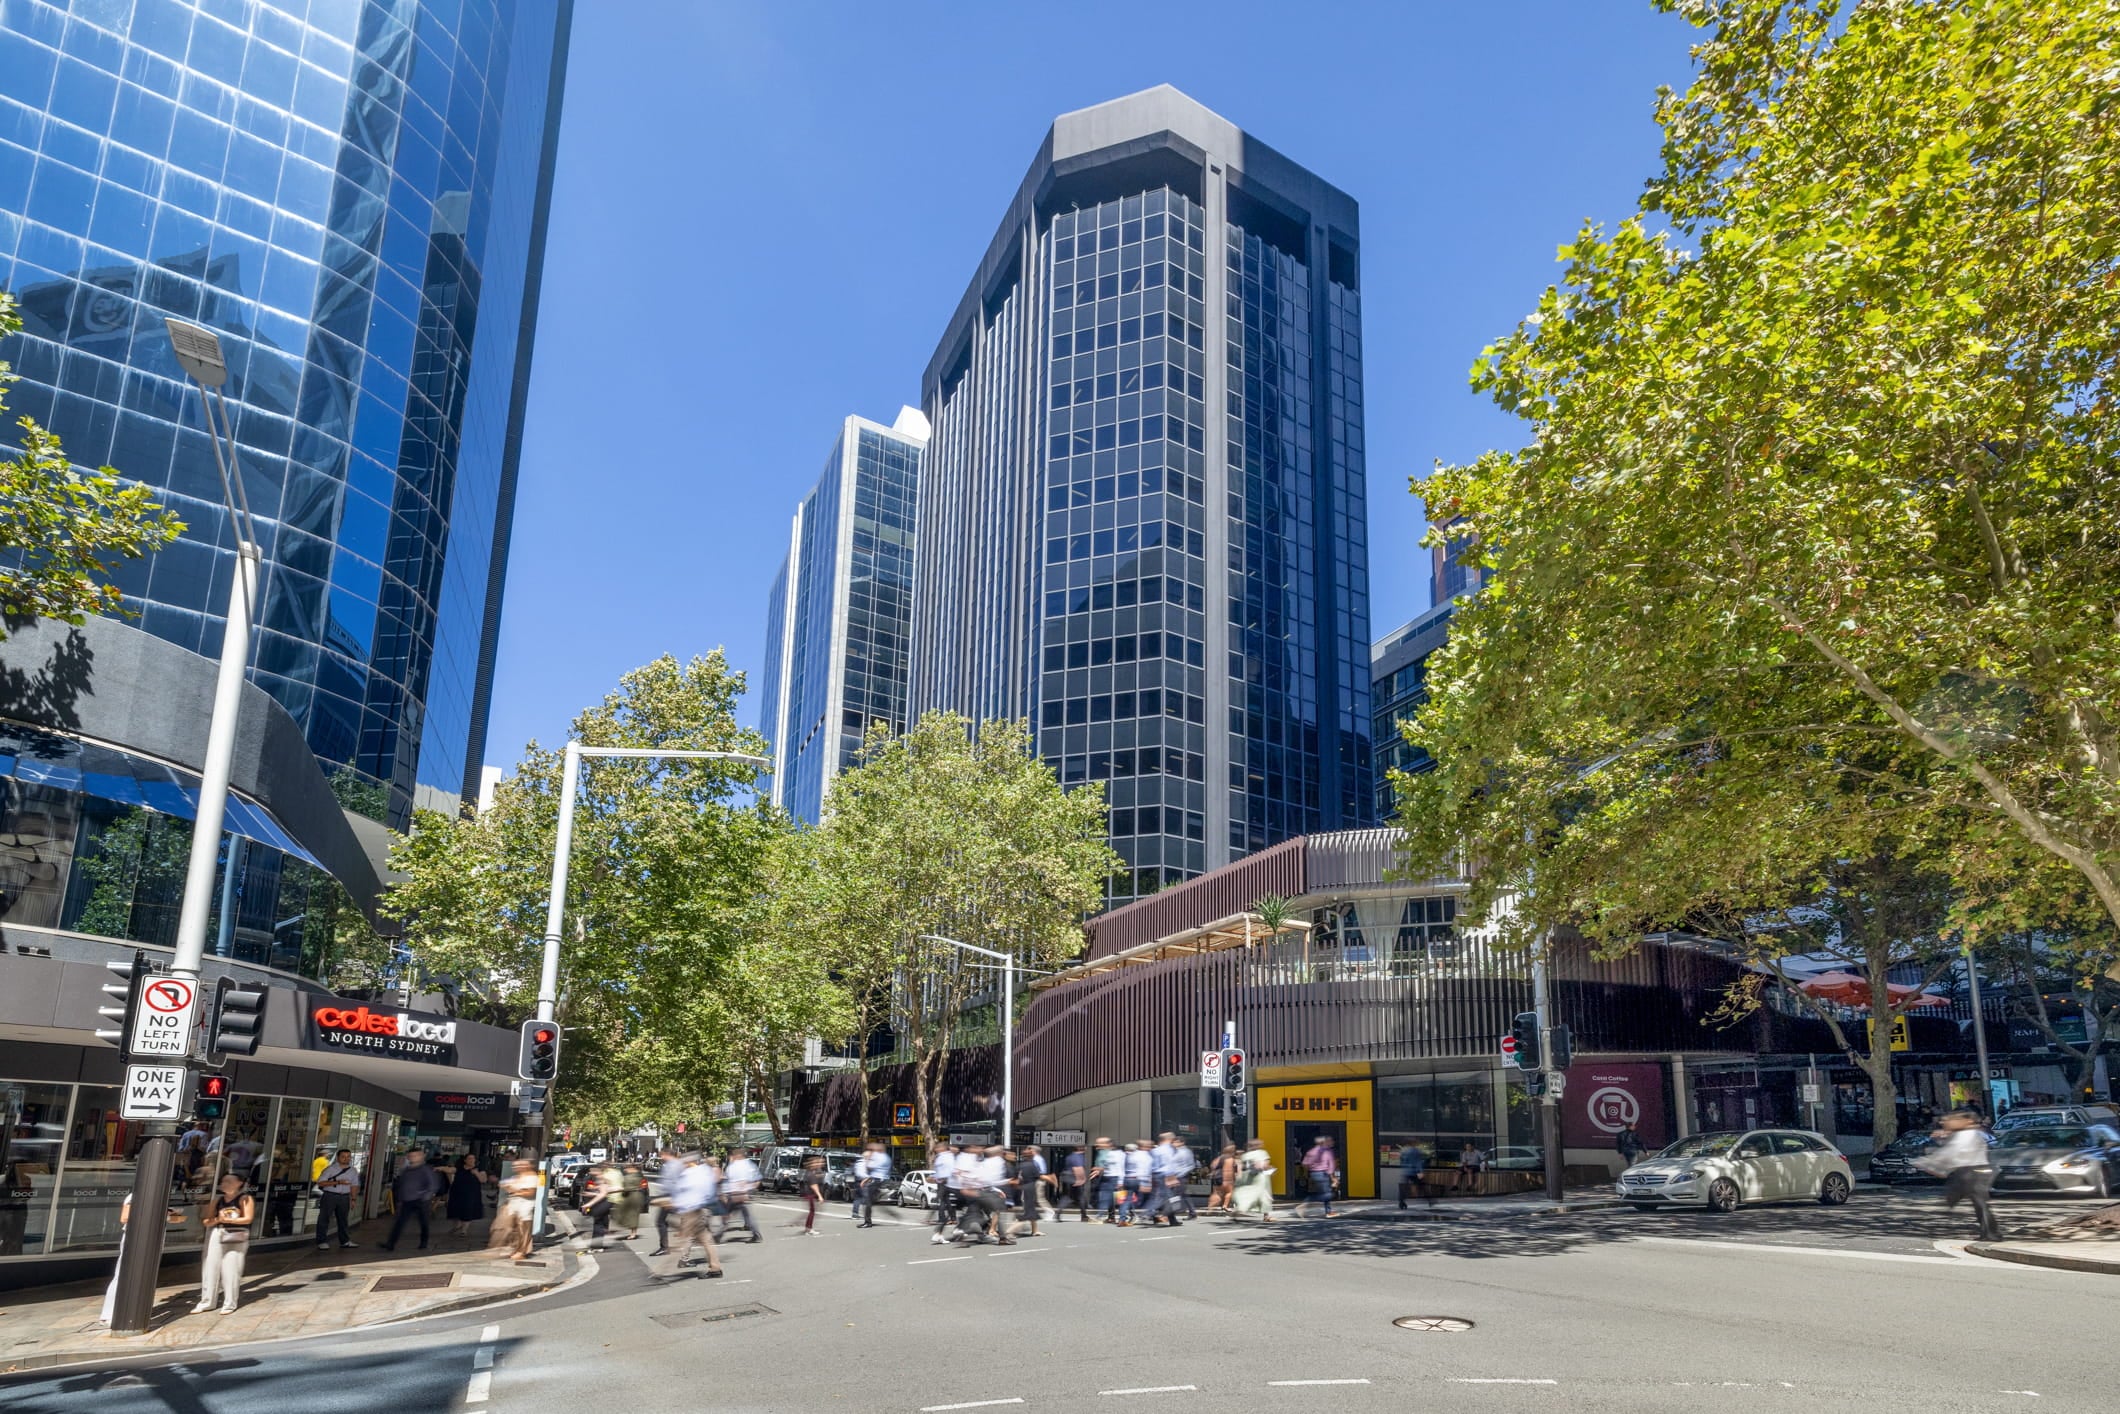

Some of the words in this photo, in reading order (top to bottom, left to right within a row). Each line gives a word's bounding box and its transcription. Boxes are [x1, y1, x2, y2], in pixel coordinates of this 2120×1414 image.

[149, 1015, 178, 1028] NO
[143, 1029, 180, 1039] LEFT
[141, 1040, 180, 1050] TURN
[330, 1031, 384, 1047] NORTH
[389, 1039, 439, 1055] SYDNEY
[137, 1070, 176, 1083] ONE
[1970, 1069, 2005, 1079] ADI
[132, 1086, 176, 1099] WAY
[467, 1095, 496, 1105] local
[1274, 1097, 1304, 1110] JB
[1056, 1134, 1066, 1142] EAT
[11, 1190, 38, 1198] local
[73, 1189, 97, 1197] local
[107, 1188, 130, 1196] local
